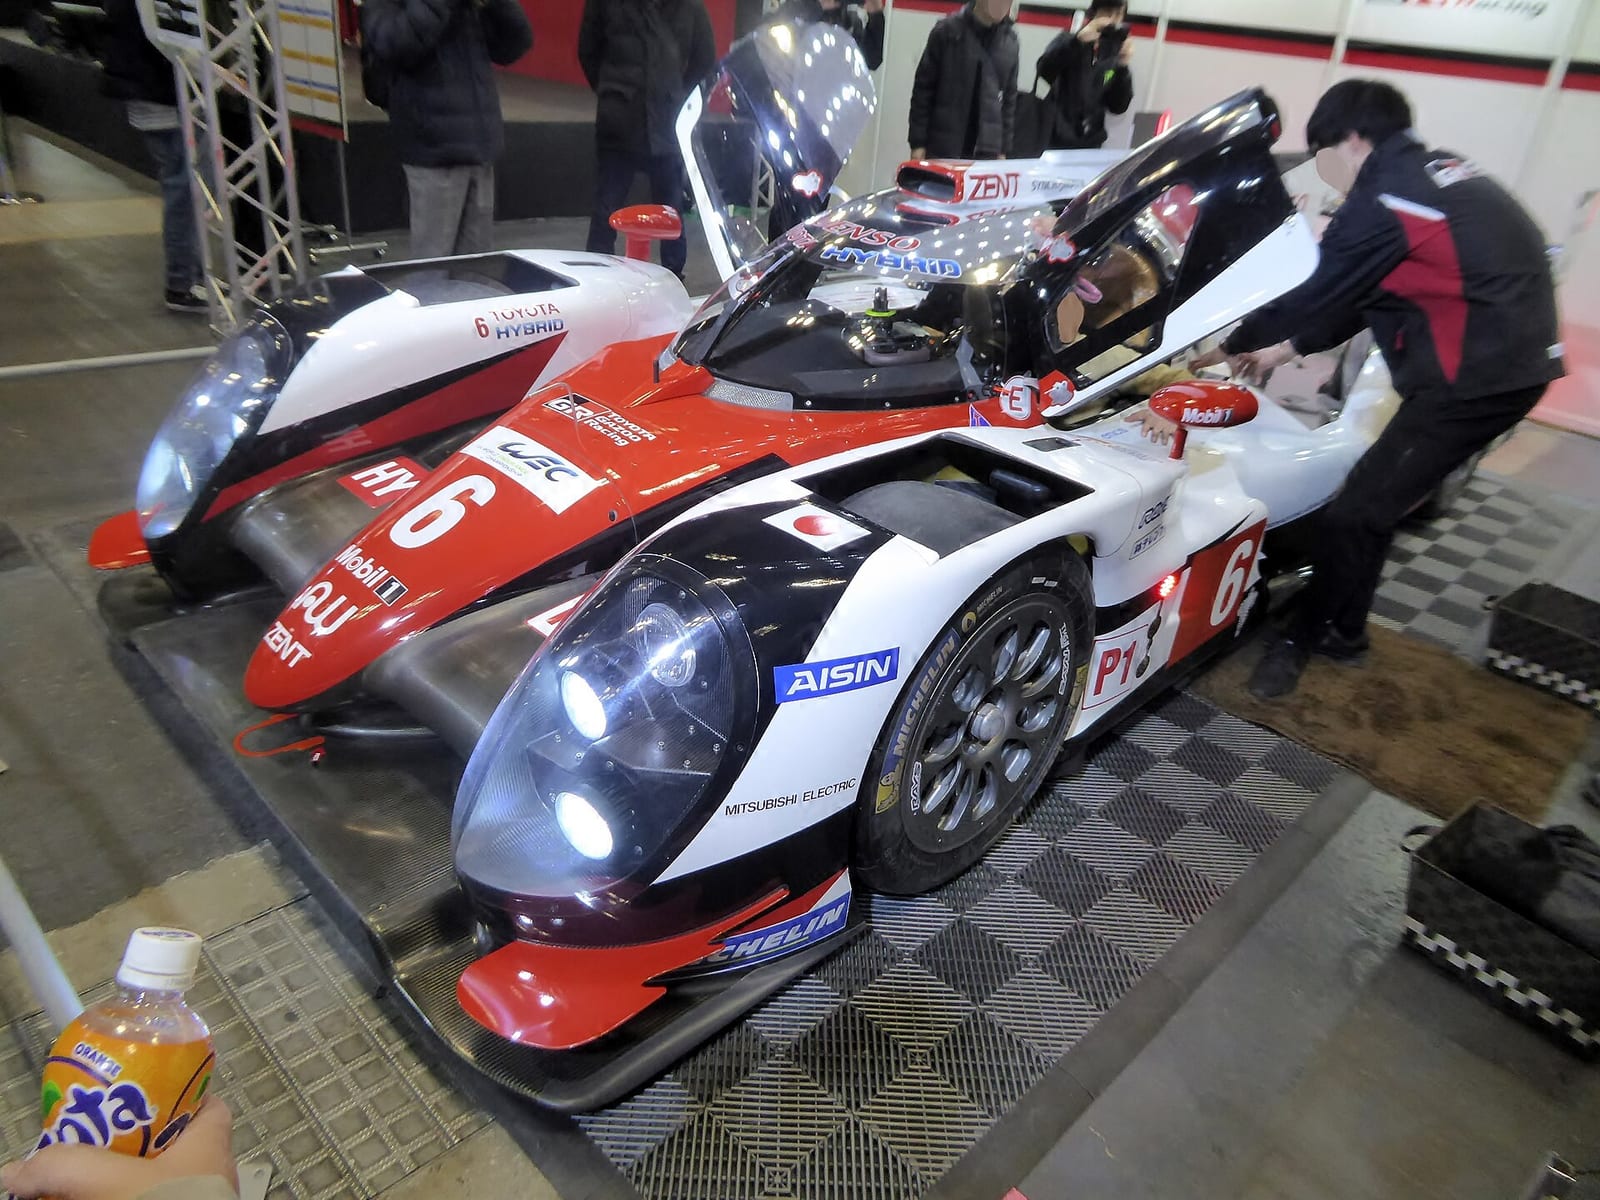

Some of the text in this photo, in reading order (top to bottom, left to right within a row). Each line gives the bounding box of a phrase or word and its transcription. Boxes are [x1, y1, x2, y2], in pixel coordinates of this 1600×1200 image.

[968, 173, 1020, 200] ZENT
[820, 245, 963, 279] HYBRID
[473, 316, 490, 338] 6
[489, 302, 560, 322] TOYOTA
[495, 318, 565, 340] HYBRID
[547, 398, 595, 421] GR
[606, 410, 657, 441] TOYOTA
[1181, 407, 1222, 424] Mobil
[584, 418, 630, 447] Racing
[595, 415, 642, 443] GAZOO
[497, 441, 579, 482] WEC
[389, 474, 497, 549] 6
[335, 543, 390, 588] Mobil
[1209, 539, 1254, 627] 6
[262, 620, 313, 669] ZENT
[786, 655, 892, 696] AISIN
[1093, 639, 1138, 696] P1
[893, 634, 957, 757] MICHELIN
[725, 778, 857, 816] MITSUBISHI ELECTRIC
[706, 902, 846, 962] CHELIN
